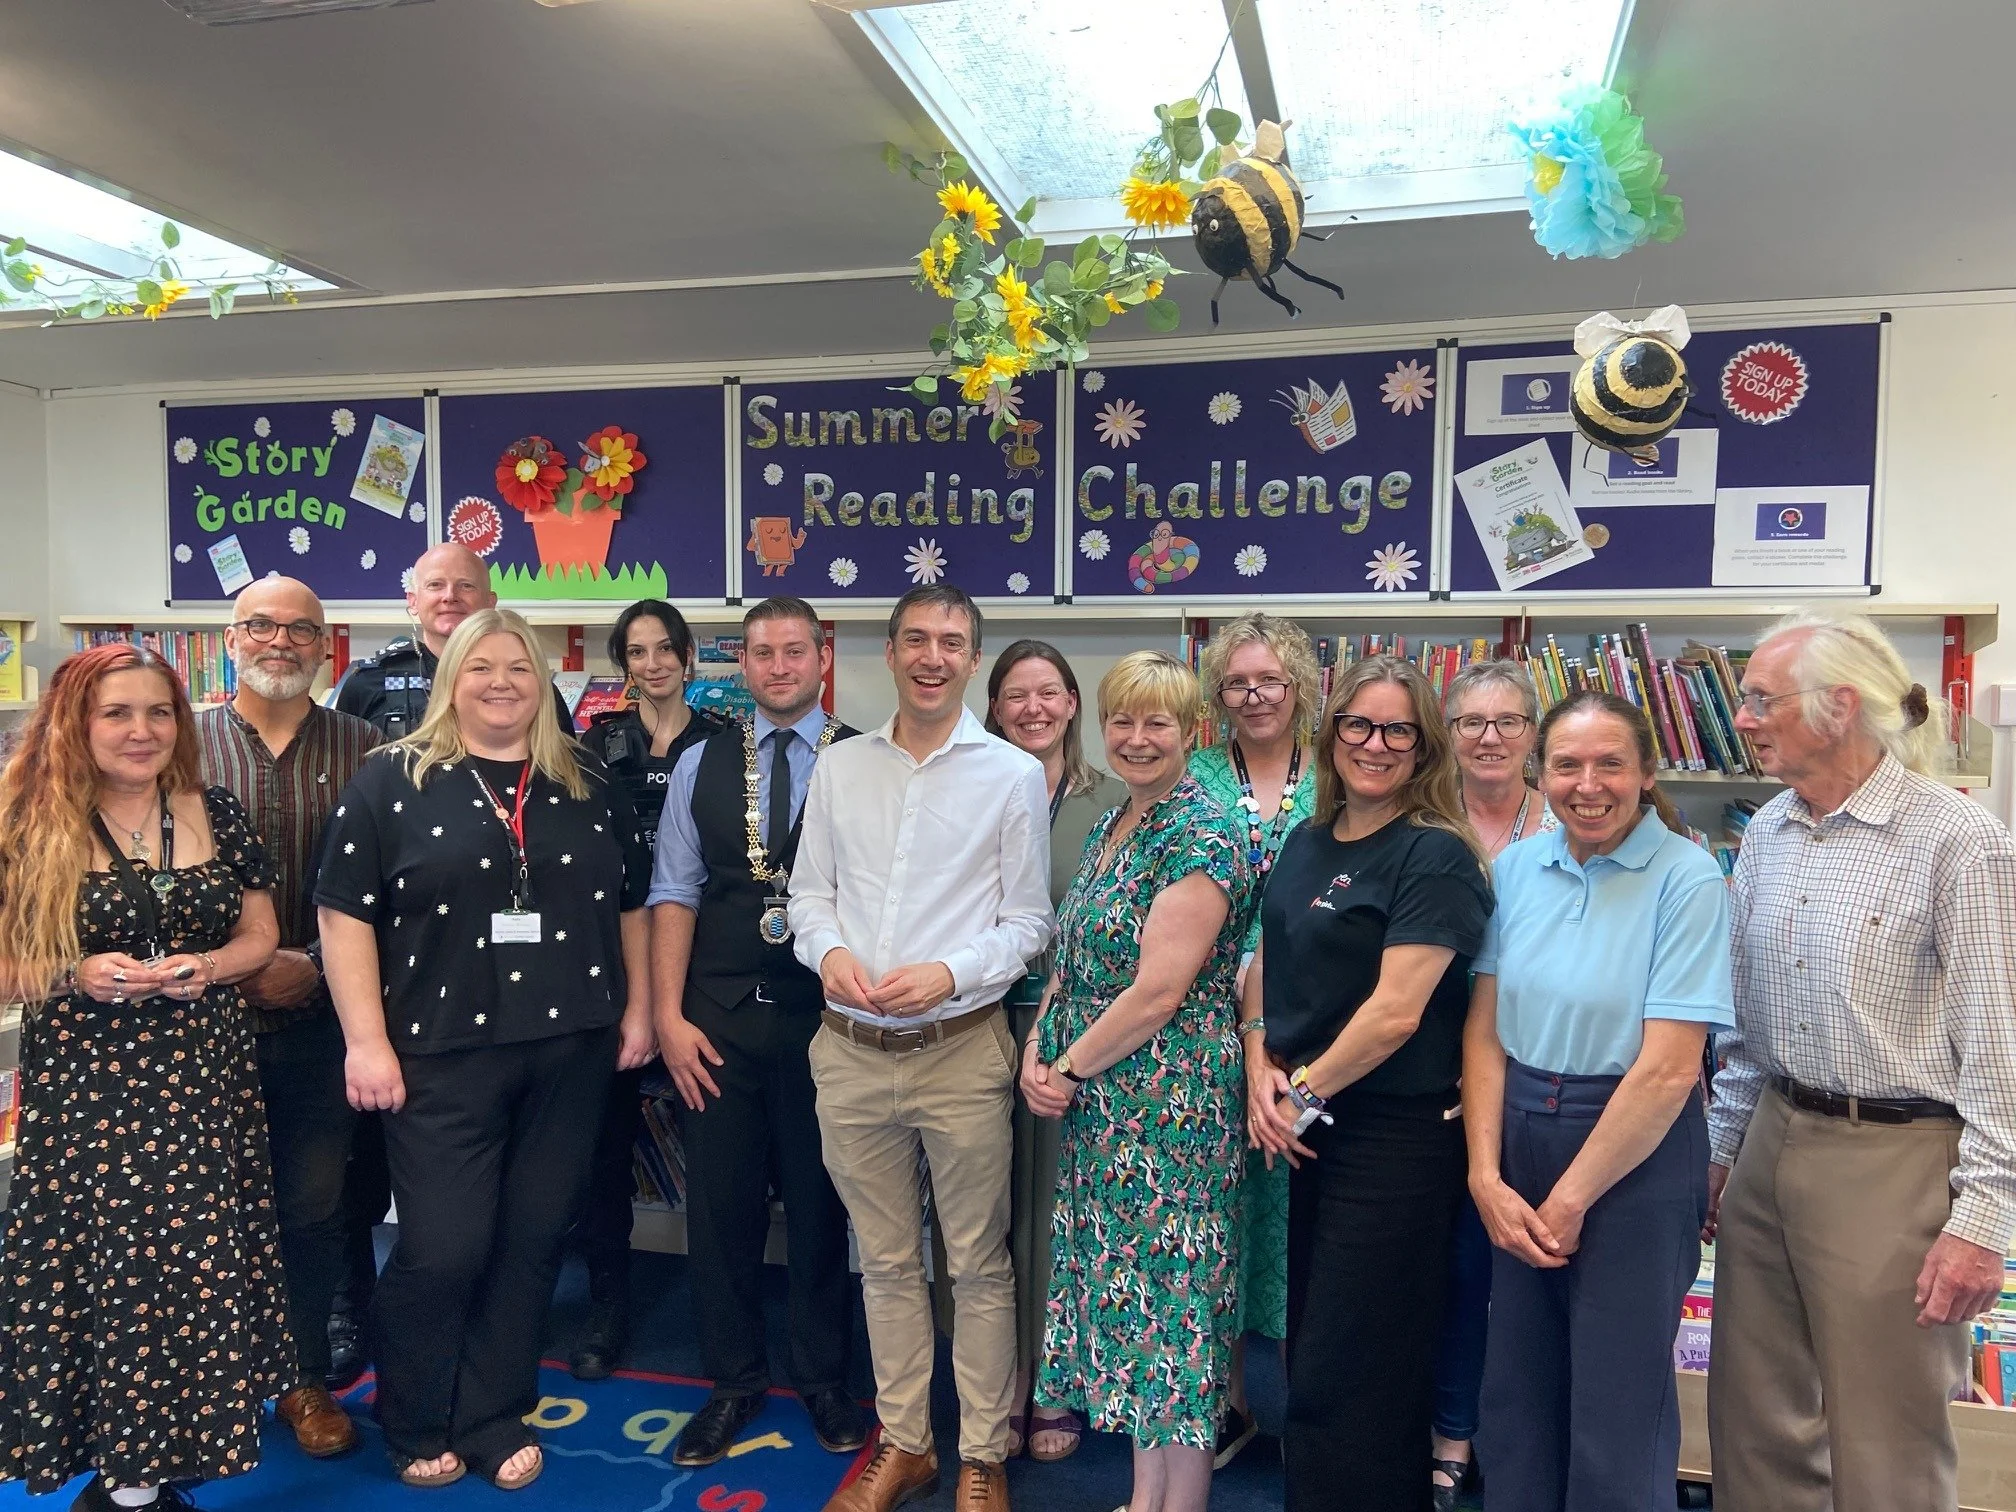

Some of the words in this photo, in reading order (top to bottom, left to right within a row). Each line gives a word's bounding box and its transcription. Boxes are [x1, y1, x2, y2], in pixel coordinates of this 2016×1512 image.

[1737, 373, 1788, 404] TODAY
[1741, 361, 1774, 383] SIGN
[1774, 374, 1794, 390] UP
[746, 395, 980, 449] Summer
[205, 436, 338, 477] Story
[1492, 460, 1517, 475] Story
[1491, 466, 1523, 482] Garden
[1495, 475, 1528, 493] Certificate
[194, 486, 346, 532] Garden
[803, 471, 1035, 543] Reading
[1078, 459, 1412, 535] Challenge
[456, 517, 477, 535] SIGN
[477, 511, 489, 523] UP
[459, 520, 493, 544] TODAY
[1696, 1305, 1712, 1318] THE
[1679, 1349, 1688, 1361] A
[1689, 1349, 1711, 1360] PHI
